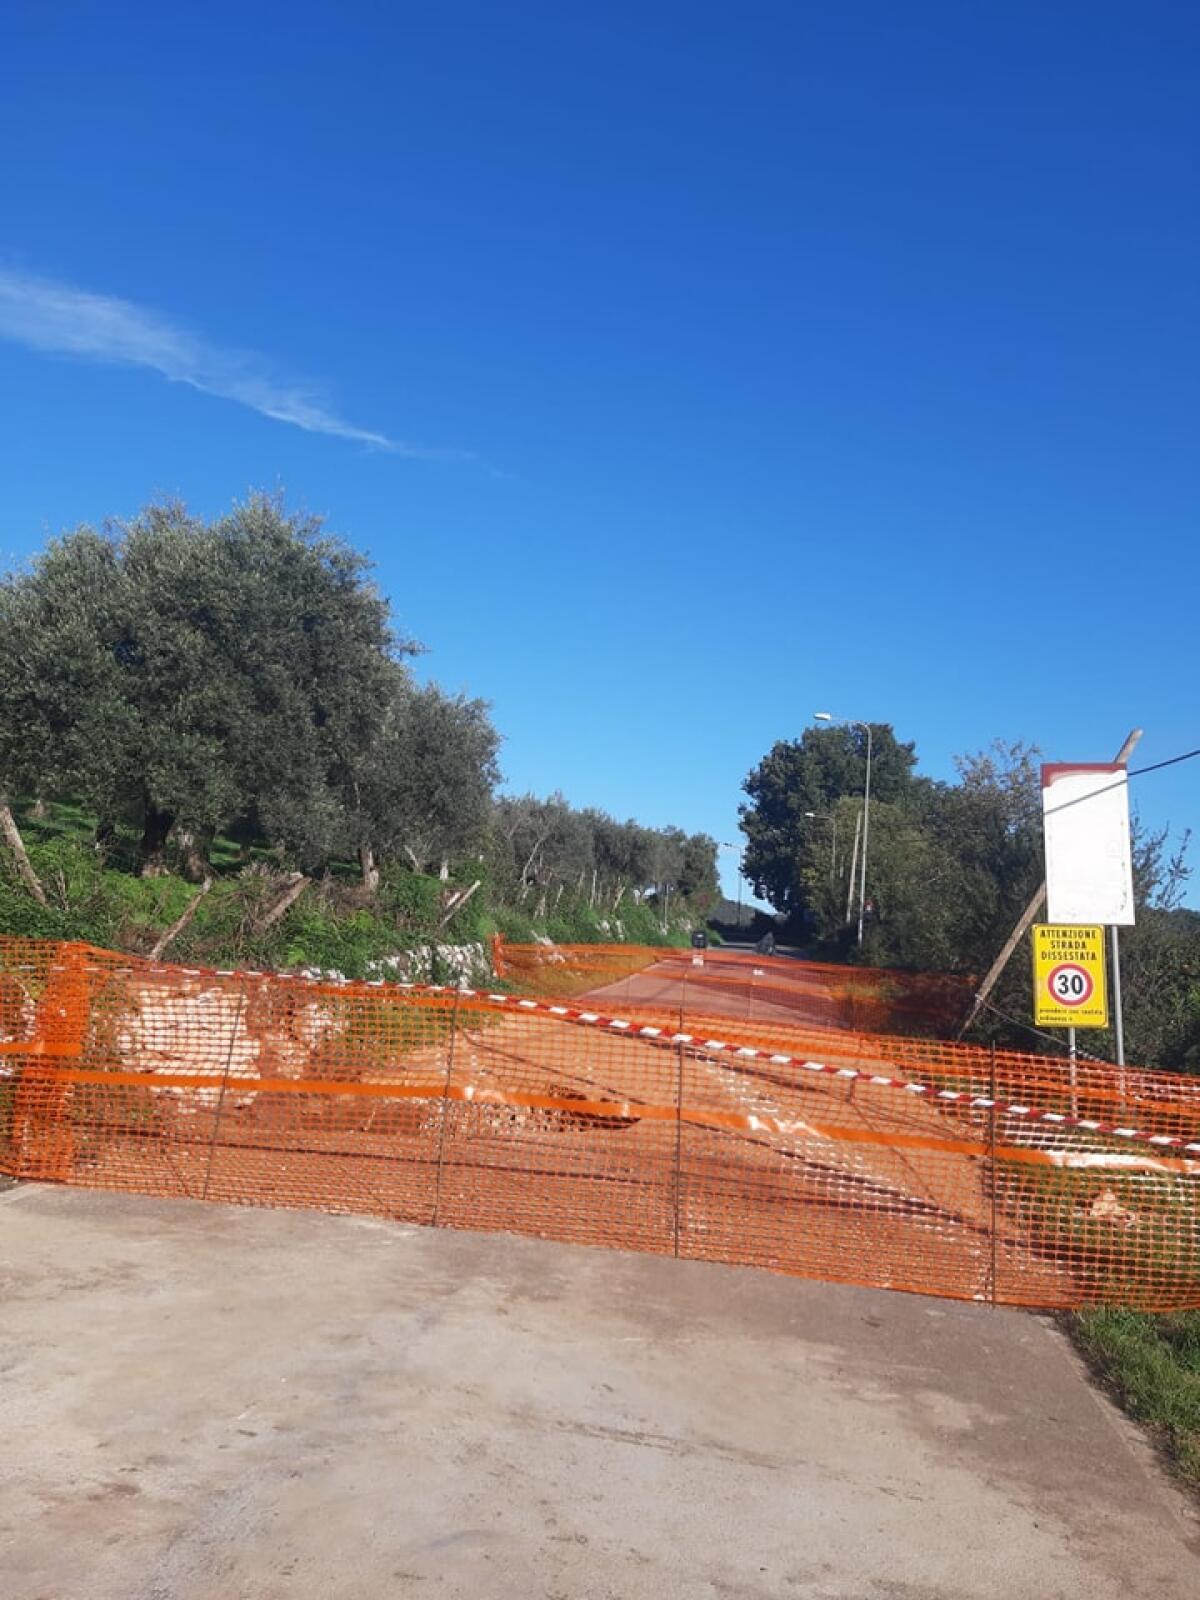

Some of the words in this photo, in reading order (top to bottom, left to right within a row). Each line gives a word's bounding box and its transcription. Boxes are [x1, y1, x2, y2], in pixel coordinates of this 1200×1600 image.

[1040, 929, 1096, 939] ATTENZIONE
[1051, 940, 1087, 949] STRADA
[1041, 951, 1097, 960] DISSESTATA
[1058, 974, 1083, 995] 30
